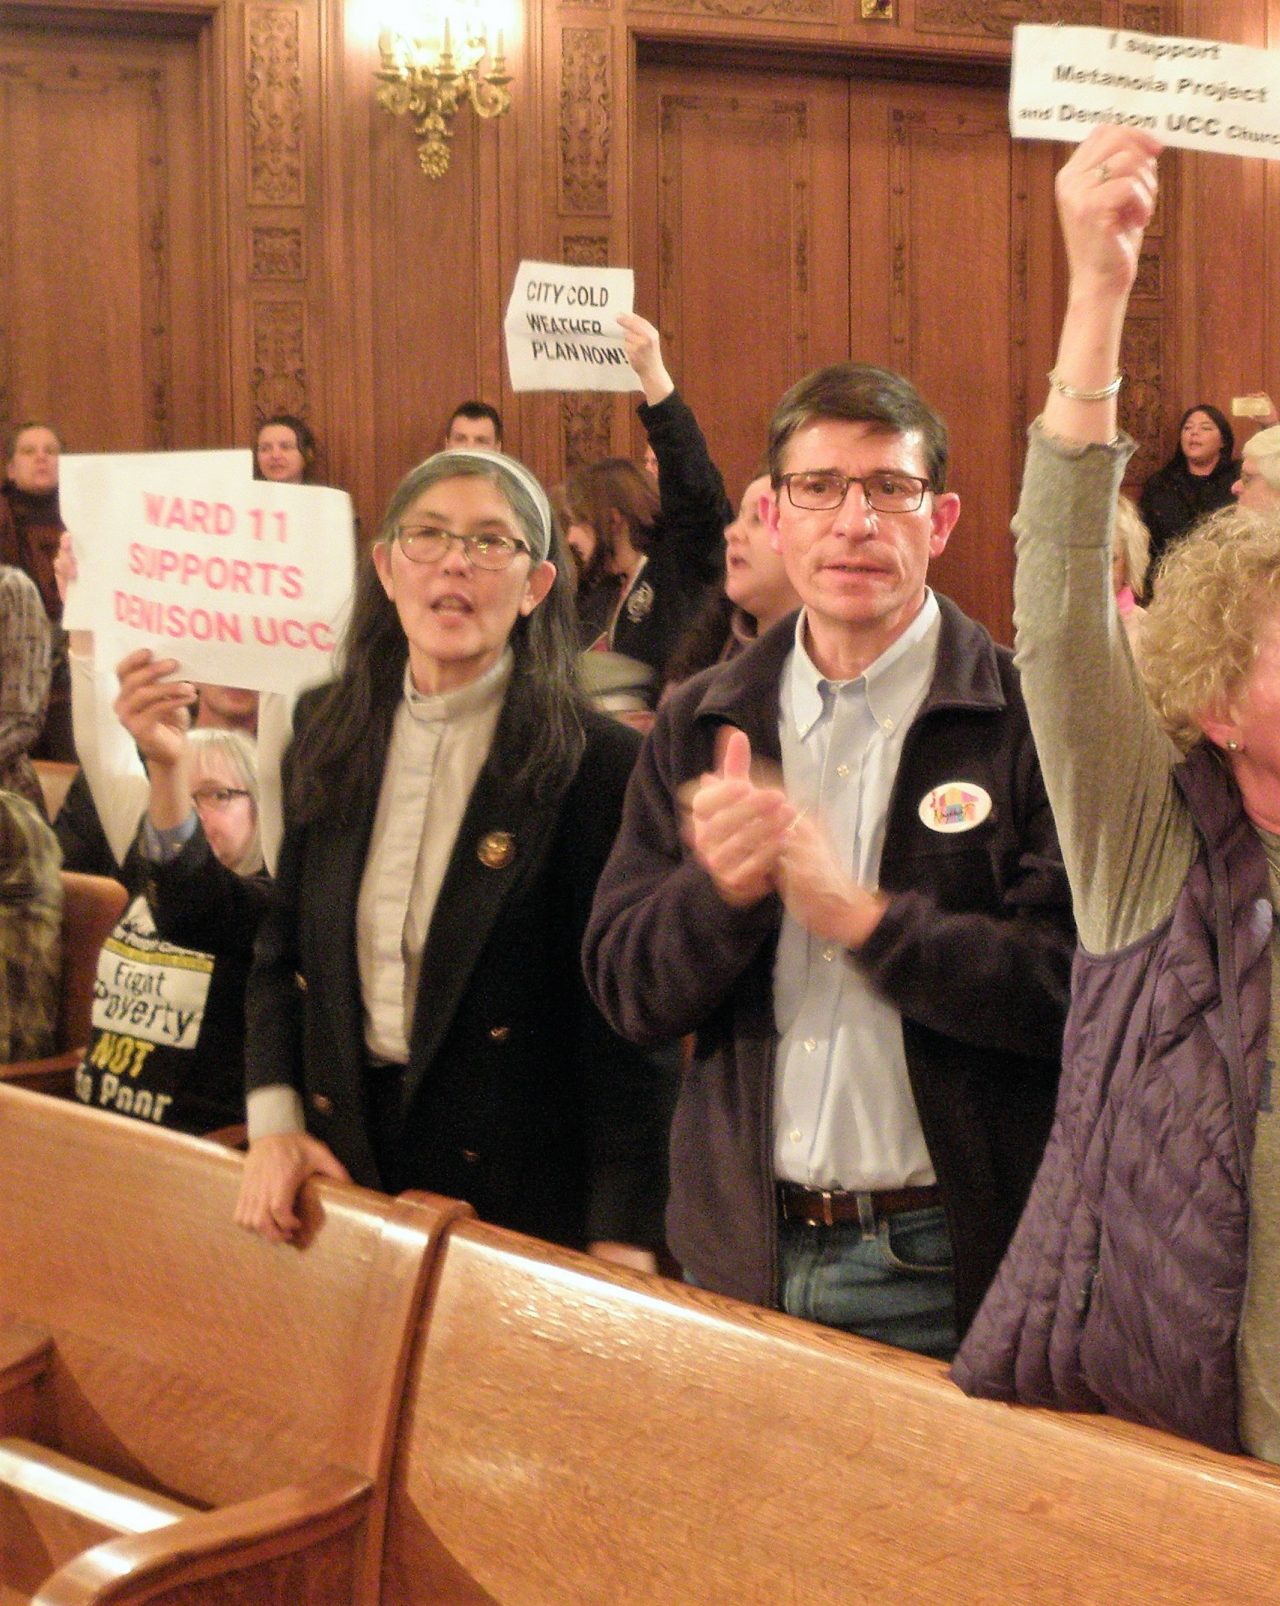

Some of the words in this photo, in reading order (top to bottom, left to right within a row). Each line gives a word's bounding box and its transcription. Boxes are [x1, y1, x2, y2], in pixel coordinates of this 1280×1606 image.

[1108, 33, 1118, 50] I
[1125, 37, 1220, 60] support
[1054, 65, 1168, 93] Metanoia
[1176, 78, 1268, 103] Project
[1018, 105, 1053, 121] and
[1057, 104, 1158, 130] Denison
[1166, 113, 1220, 137] UCC
[526, 281, 564, 304] CITY
[567, 285, 609, 307] COLD
[526, 312, 604, 337] WEATHER
[532, 340, 579, 361] PLAN
[579, 343, 629, 365] NOW!
[143, 492, 236, 537] WARD
[247, 508, 288, 543] 11
[113, 590, 244, 644] DENISON
[252, 616, 336, 652] UCC
[114, 961, 166, 997] Fight
[90, 1032, 156, 1078] NOT
